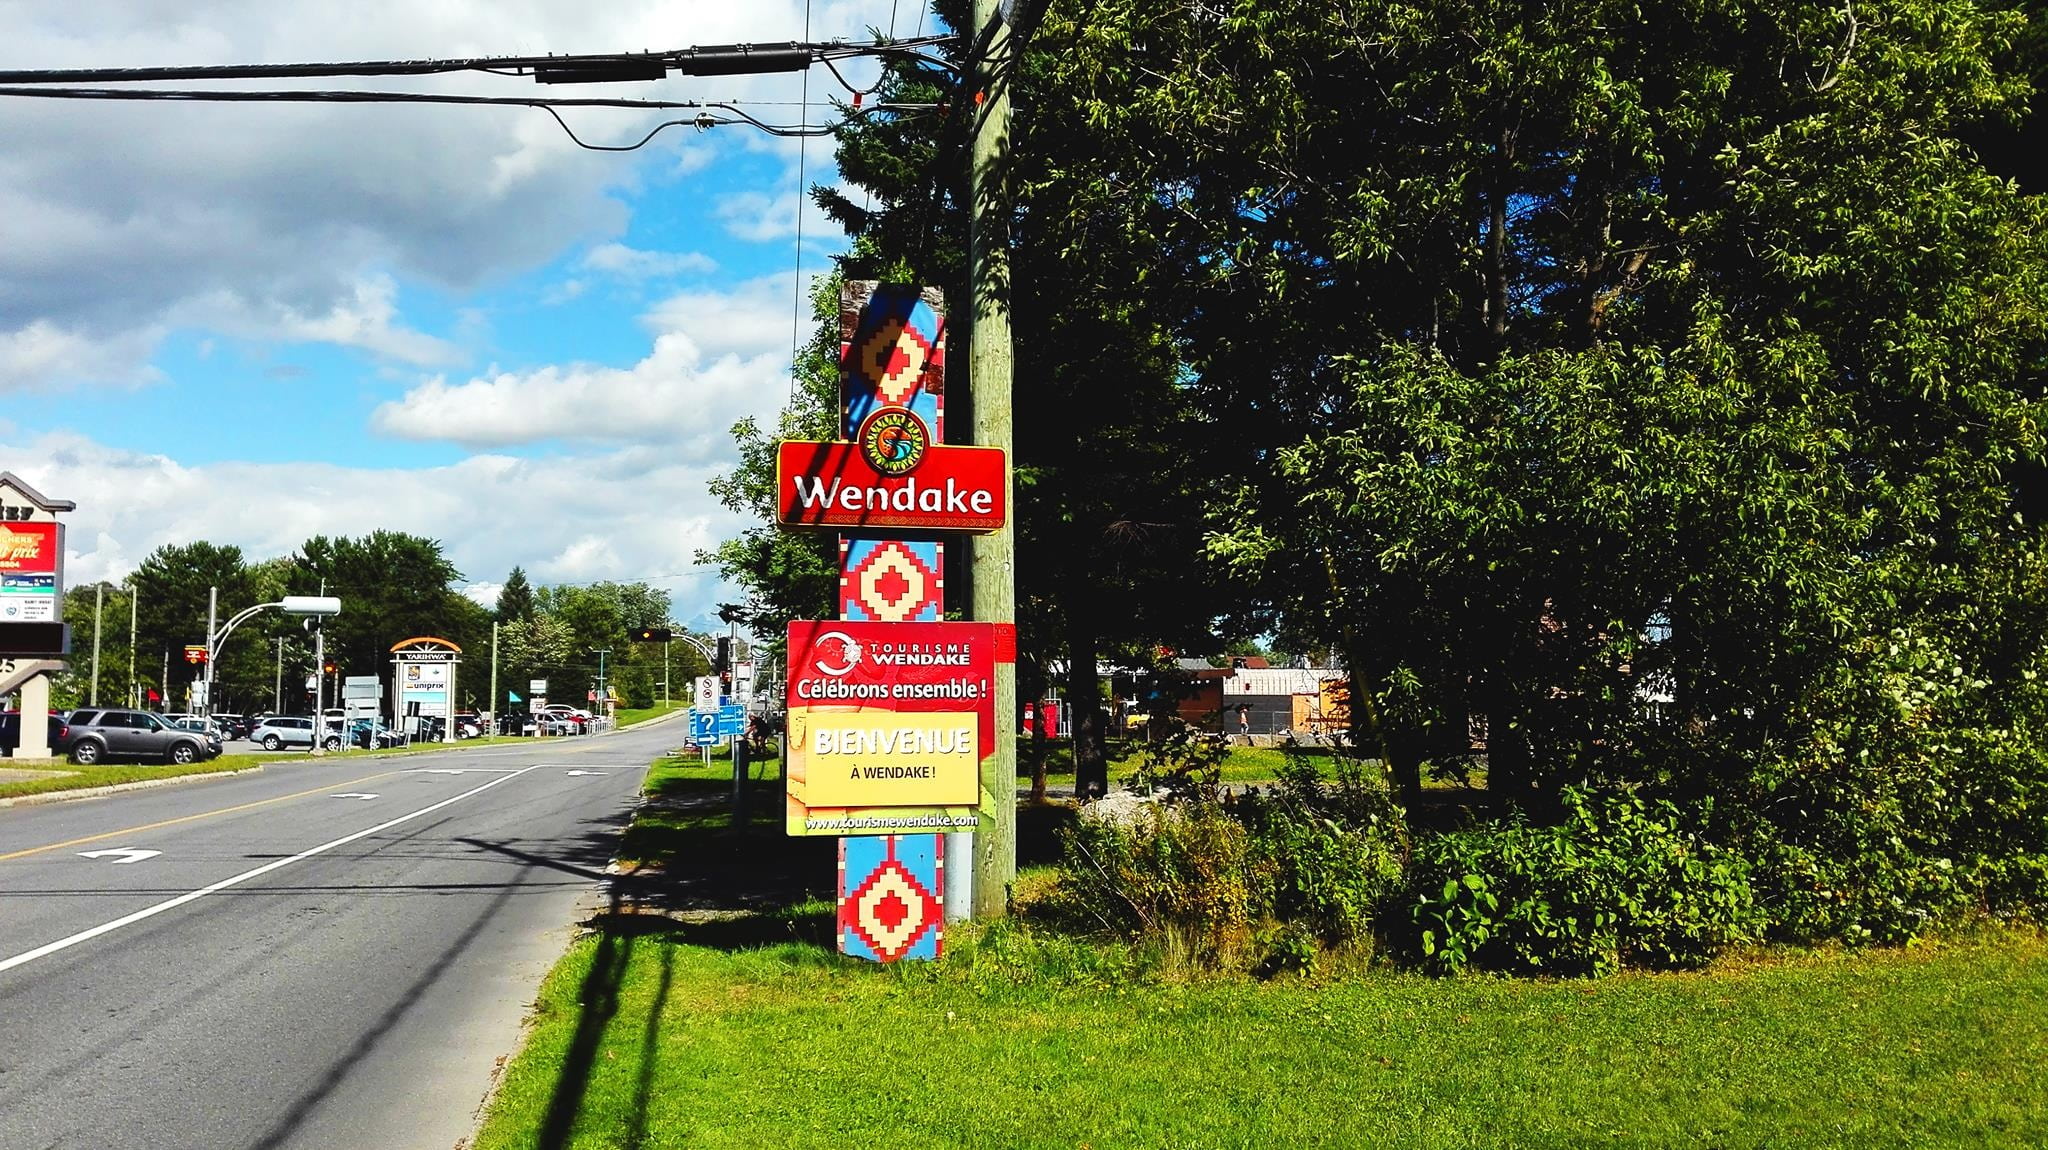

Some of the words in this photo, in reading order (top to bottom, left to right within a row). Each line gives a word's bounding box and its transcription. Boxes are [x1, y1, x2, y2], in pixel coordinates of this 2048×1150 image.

[793, 475, 993, 514] Wendake
[9, 545, 40, 561] prix
[870, 643, 970, 653] TOURISME
[872, 653, 970, 666] WENDAKE
[414, 683, 444, 691] uniprix
[797, 678, 889, 699] Célébrons
[814, 727, 971, 755] BIENVENUE
[850, 763, 860, 779] À
[805, 813, 979, 830] www.tourismewendake.com
